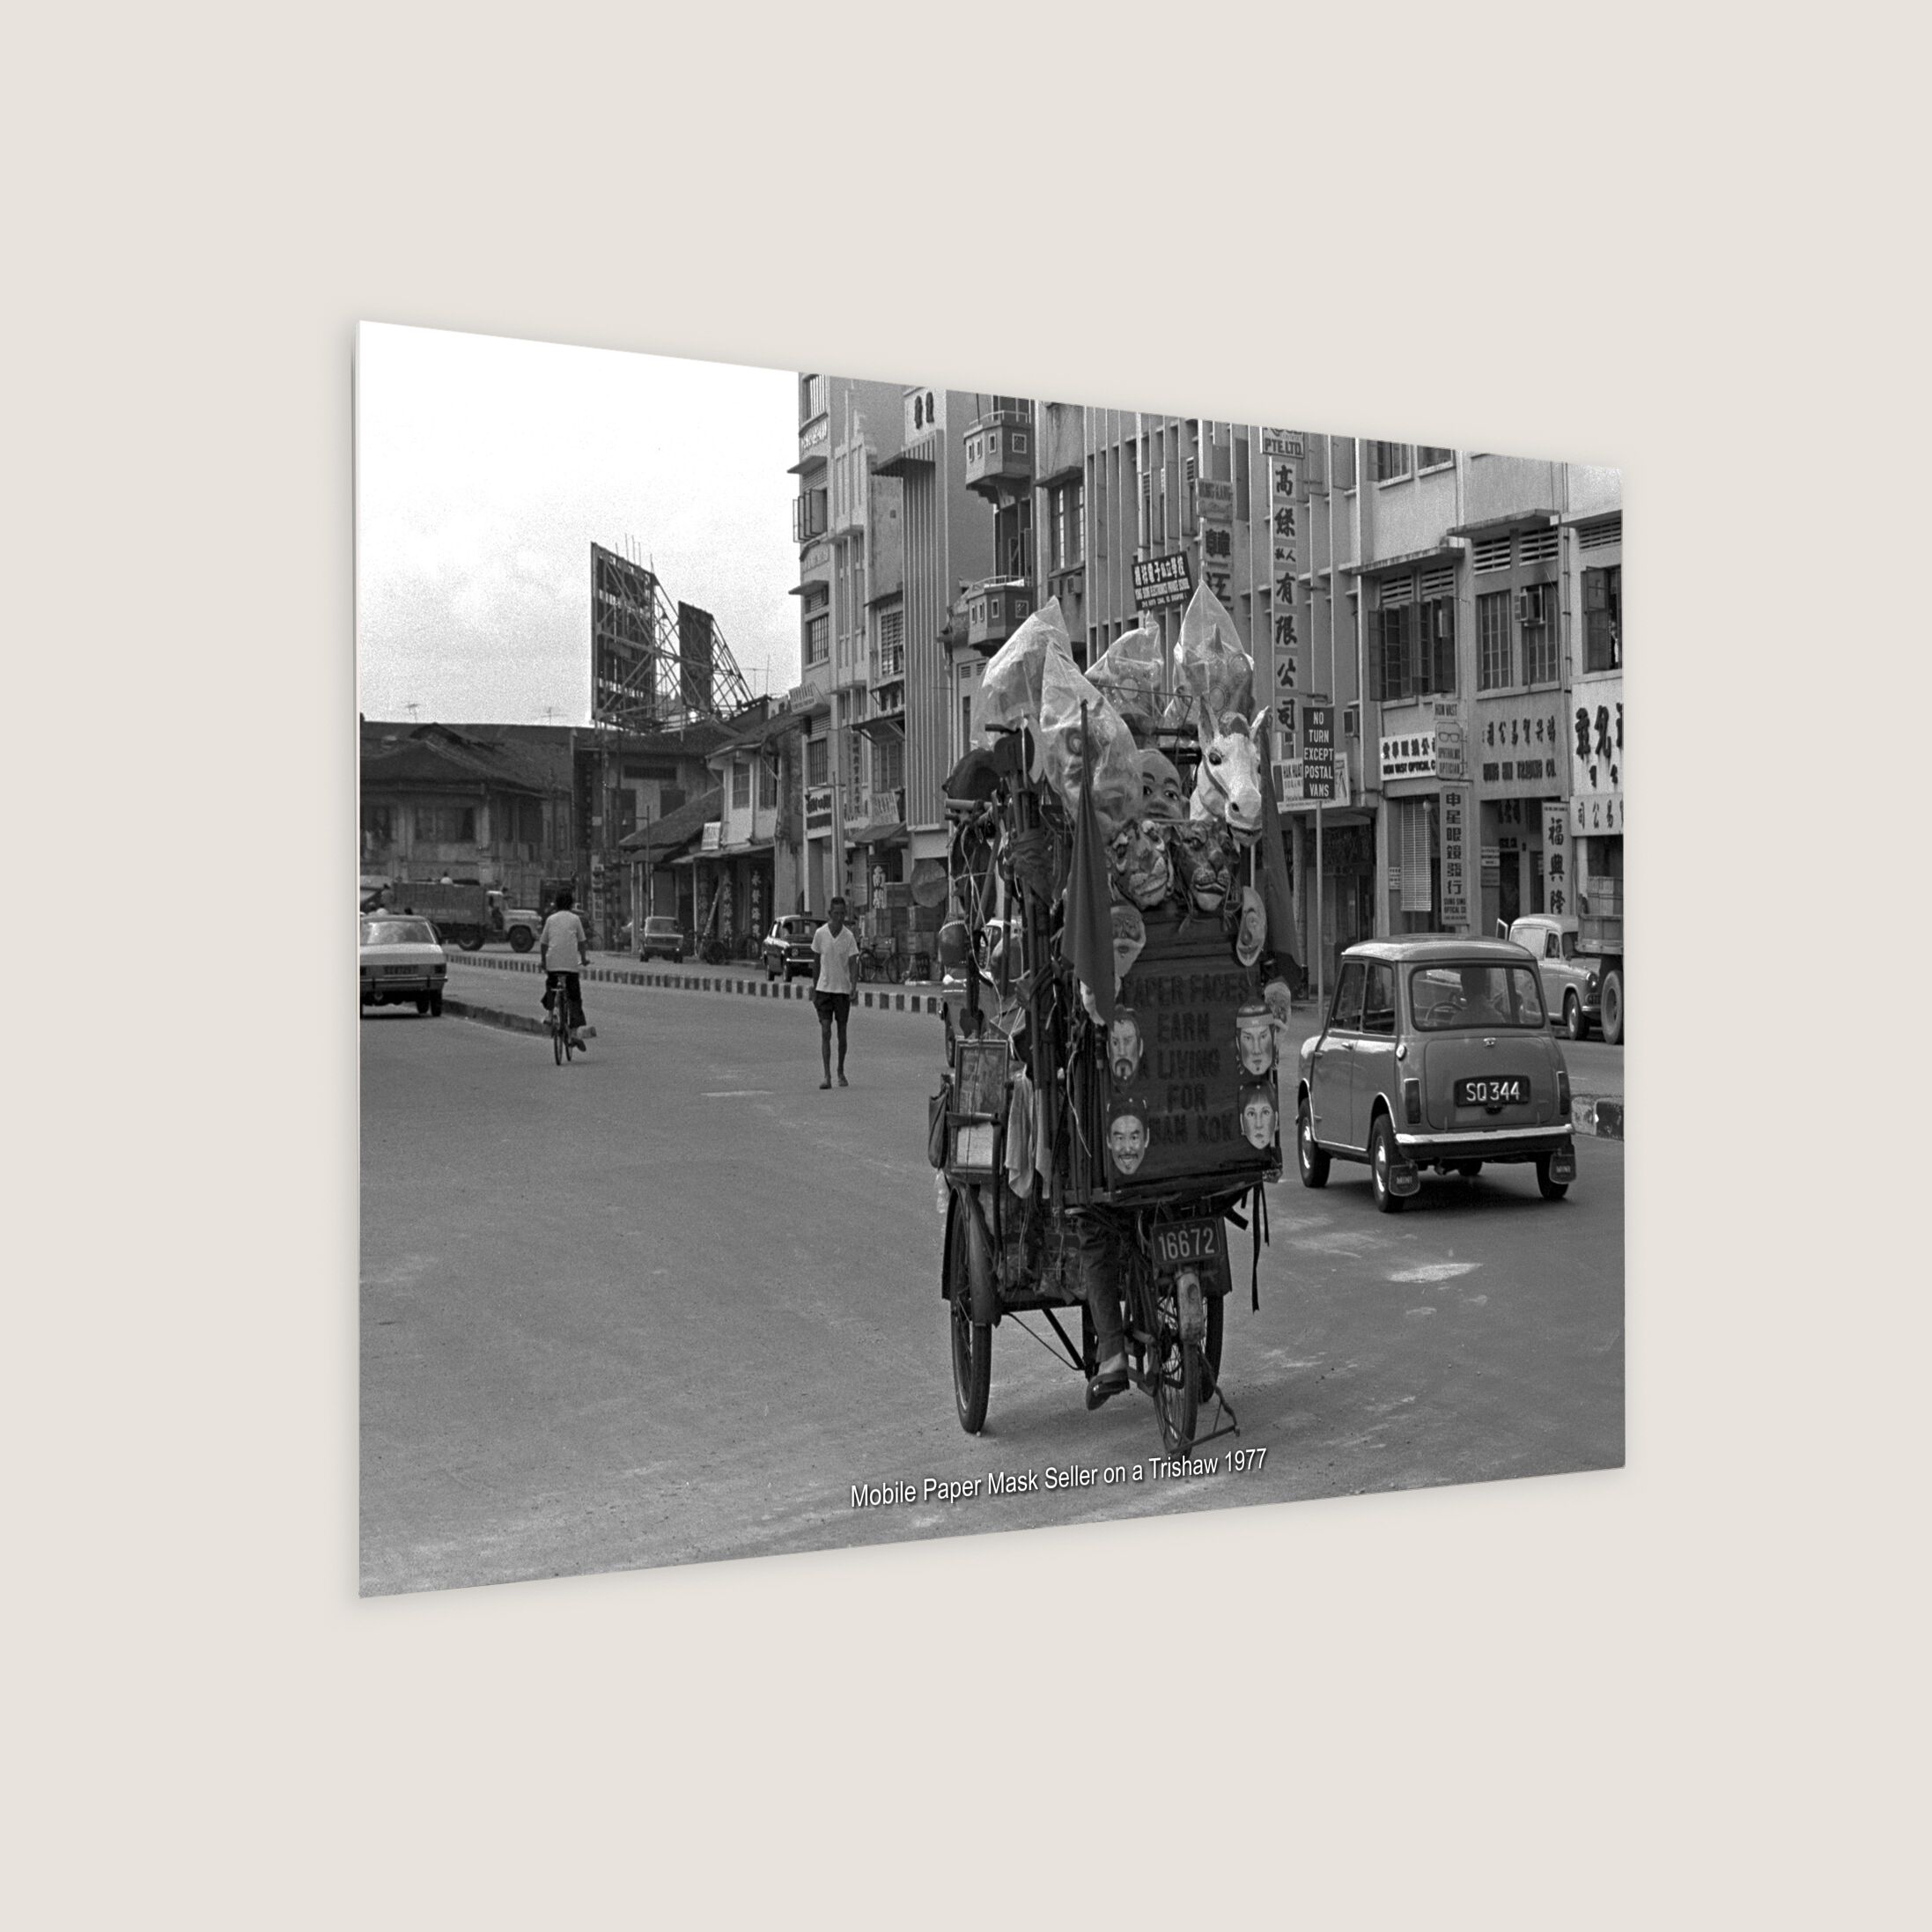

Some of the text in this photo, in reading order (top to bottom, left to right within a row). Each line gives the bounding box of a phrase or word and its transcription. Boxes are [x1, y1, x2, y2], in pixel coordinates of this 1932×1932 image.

[1313, 711, 1324, 725] NO
[1309, 729, 1330, 743] TURN
[1304, 747, 1334, 762] EXCEPT
[1304, 765, 1333, 779] POSTAL
[1309, 783, 1330, 797] VANS
[1157, 1012, 1211, 1042] EARN
[1157, 1048, 1220, 1080] LIVING
[1167, 1082, 1207, 1113] FOR
[1489, 1080, 1521, 1101] 344
[1158, 1227, 1215, 1261] 16672
